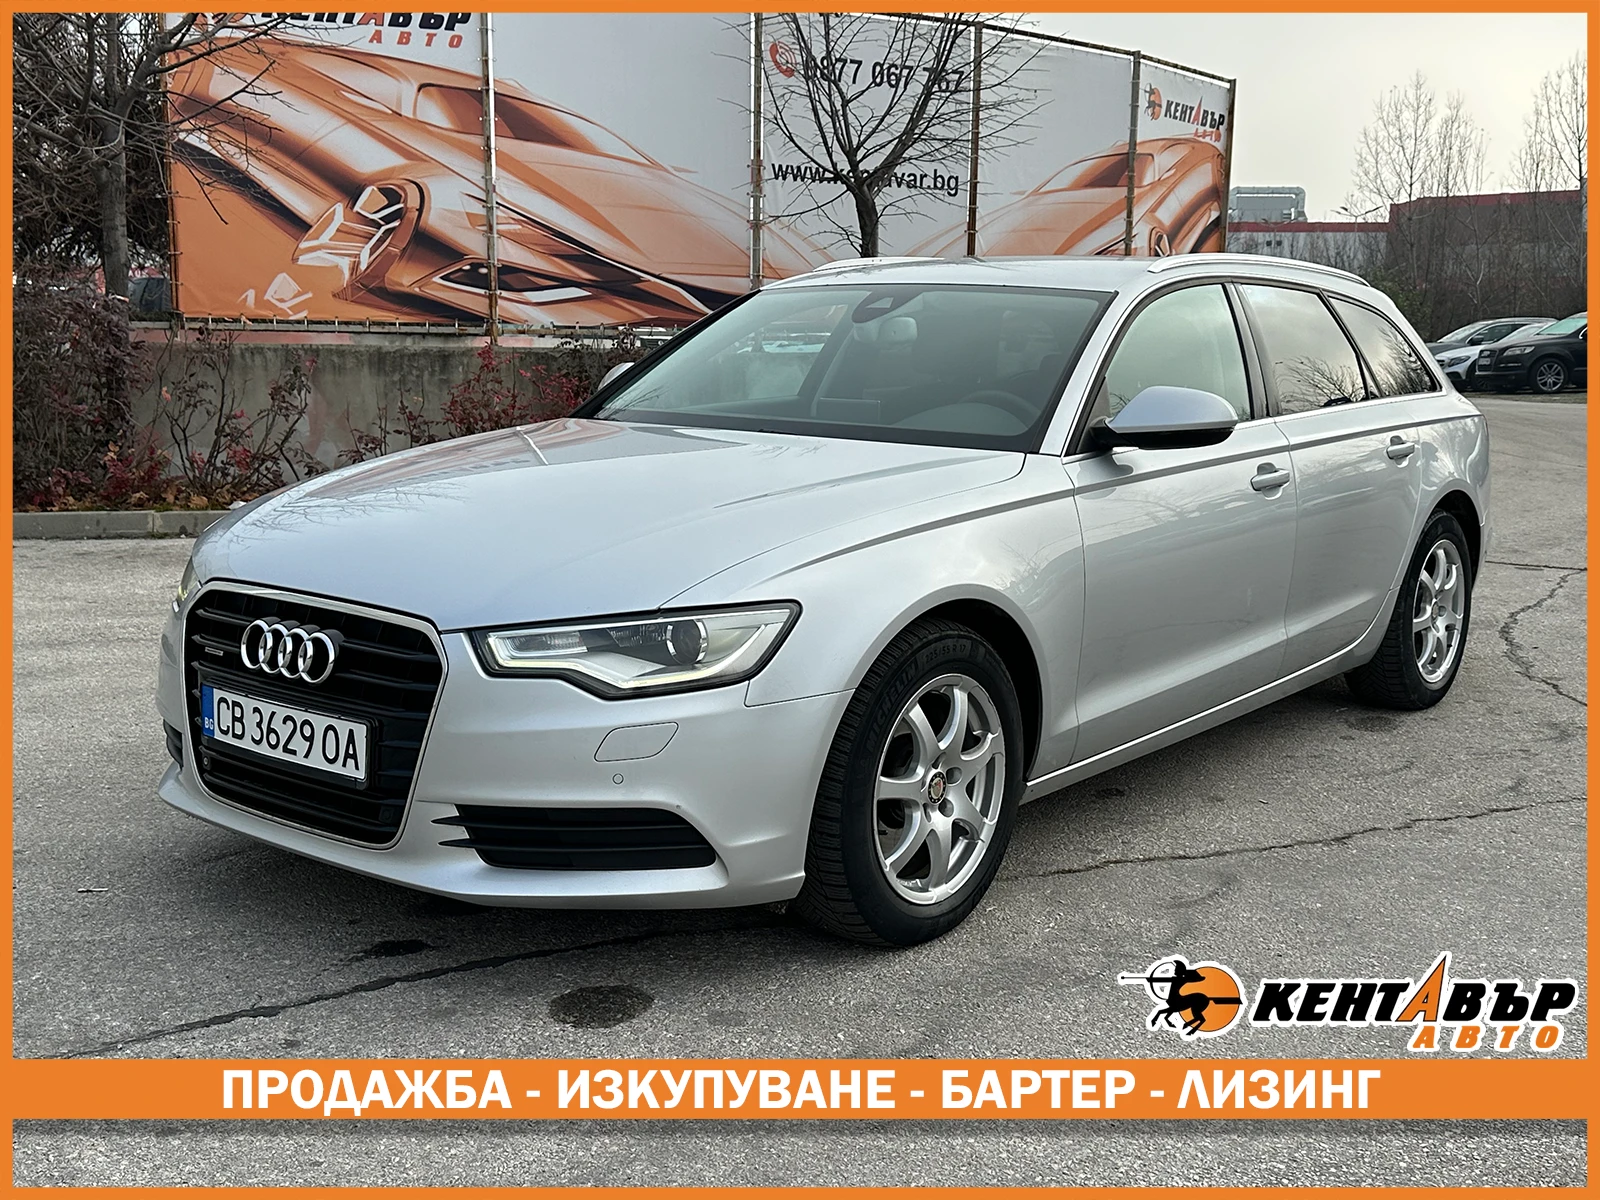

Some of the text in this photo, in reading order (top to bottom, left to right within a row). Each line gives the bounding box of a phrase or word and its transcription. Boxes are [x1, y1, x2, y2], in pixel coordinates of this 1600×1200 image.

[368, 29, 463, 48] АВТО
[871, 61, 914, 89] 067
[1164, 95, 1225, 130] КЕНТАВЪР
[866, 656, 919, 751] MICHELIN
[204, 715, 214, 731] BG
[251, 707, 315, 759] 3629
